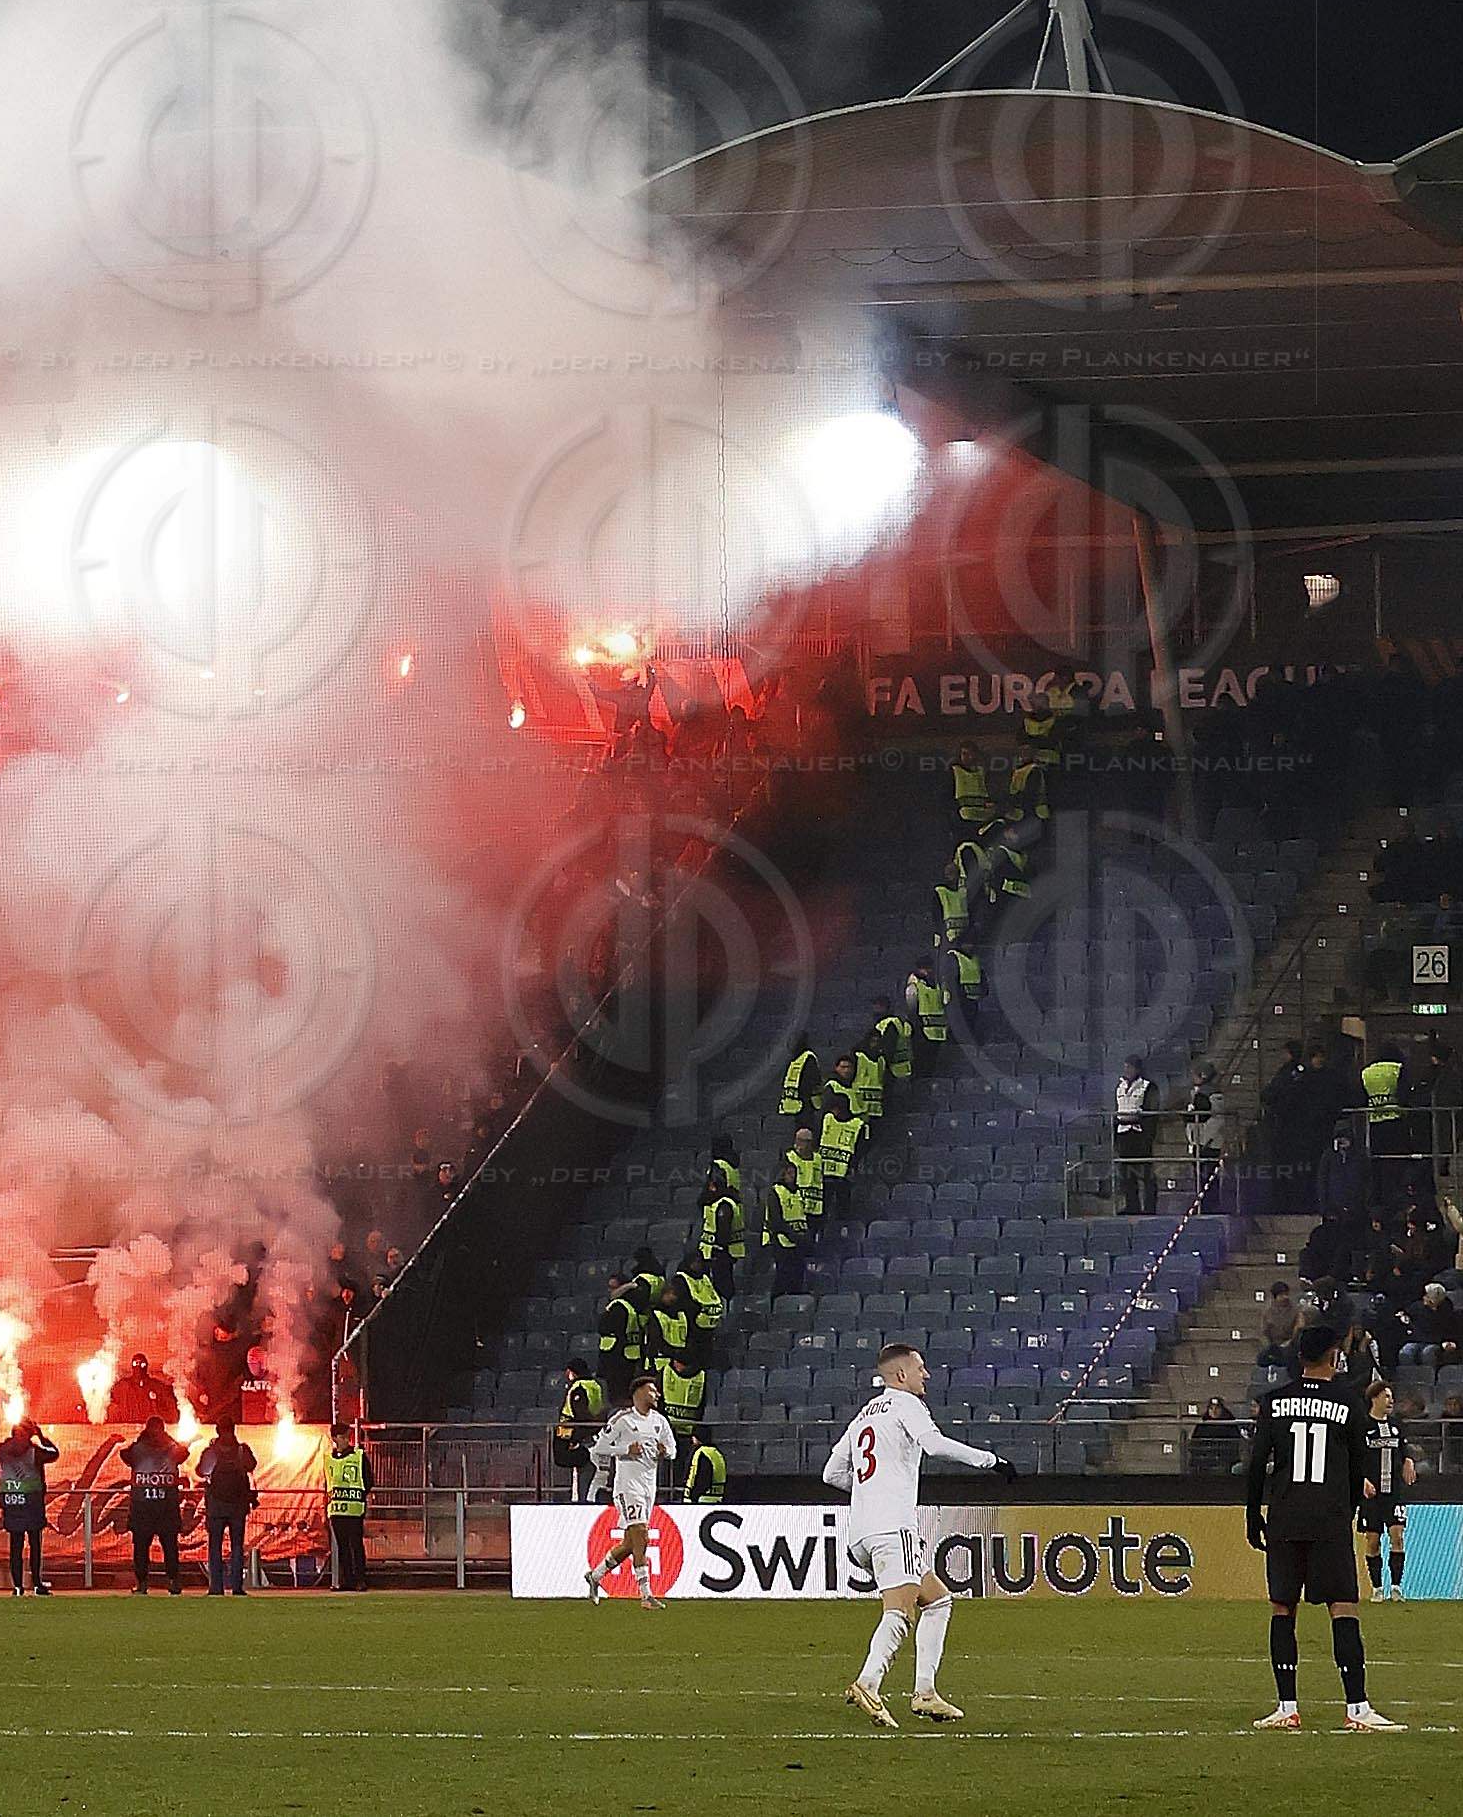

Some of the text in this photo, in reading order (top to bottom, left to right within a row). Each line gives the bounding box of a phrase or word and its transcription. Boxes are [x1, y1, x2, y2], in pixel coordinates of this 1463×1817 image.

[1416, 950, 1446, 979] 26
[1271, 1397, 1350, 1425] SARKARIA
[856, 1426, 877, 1484] 3
[1289, 1421, 1328, 1484] 11
[5, 1480, 22, 1490] TV
[135, 1473, 174, 1485] PHOTO
[627, 1504, 643, 1521] 27
